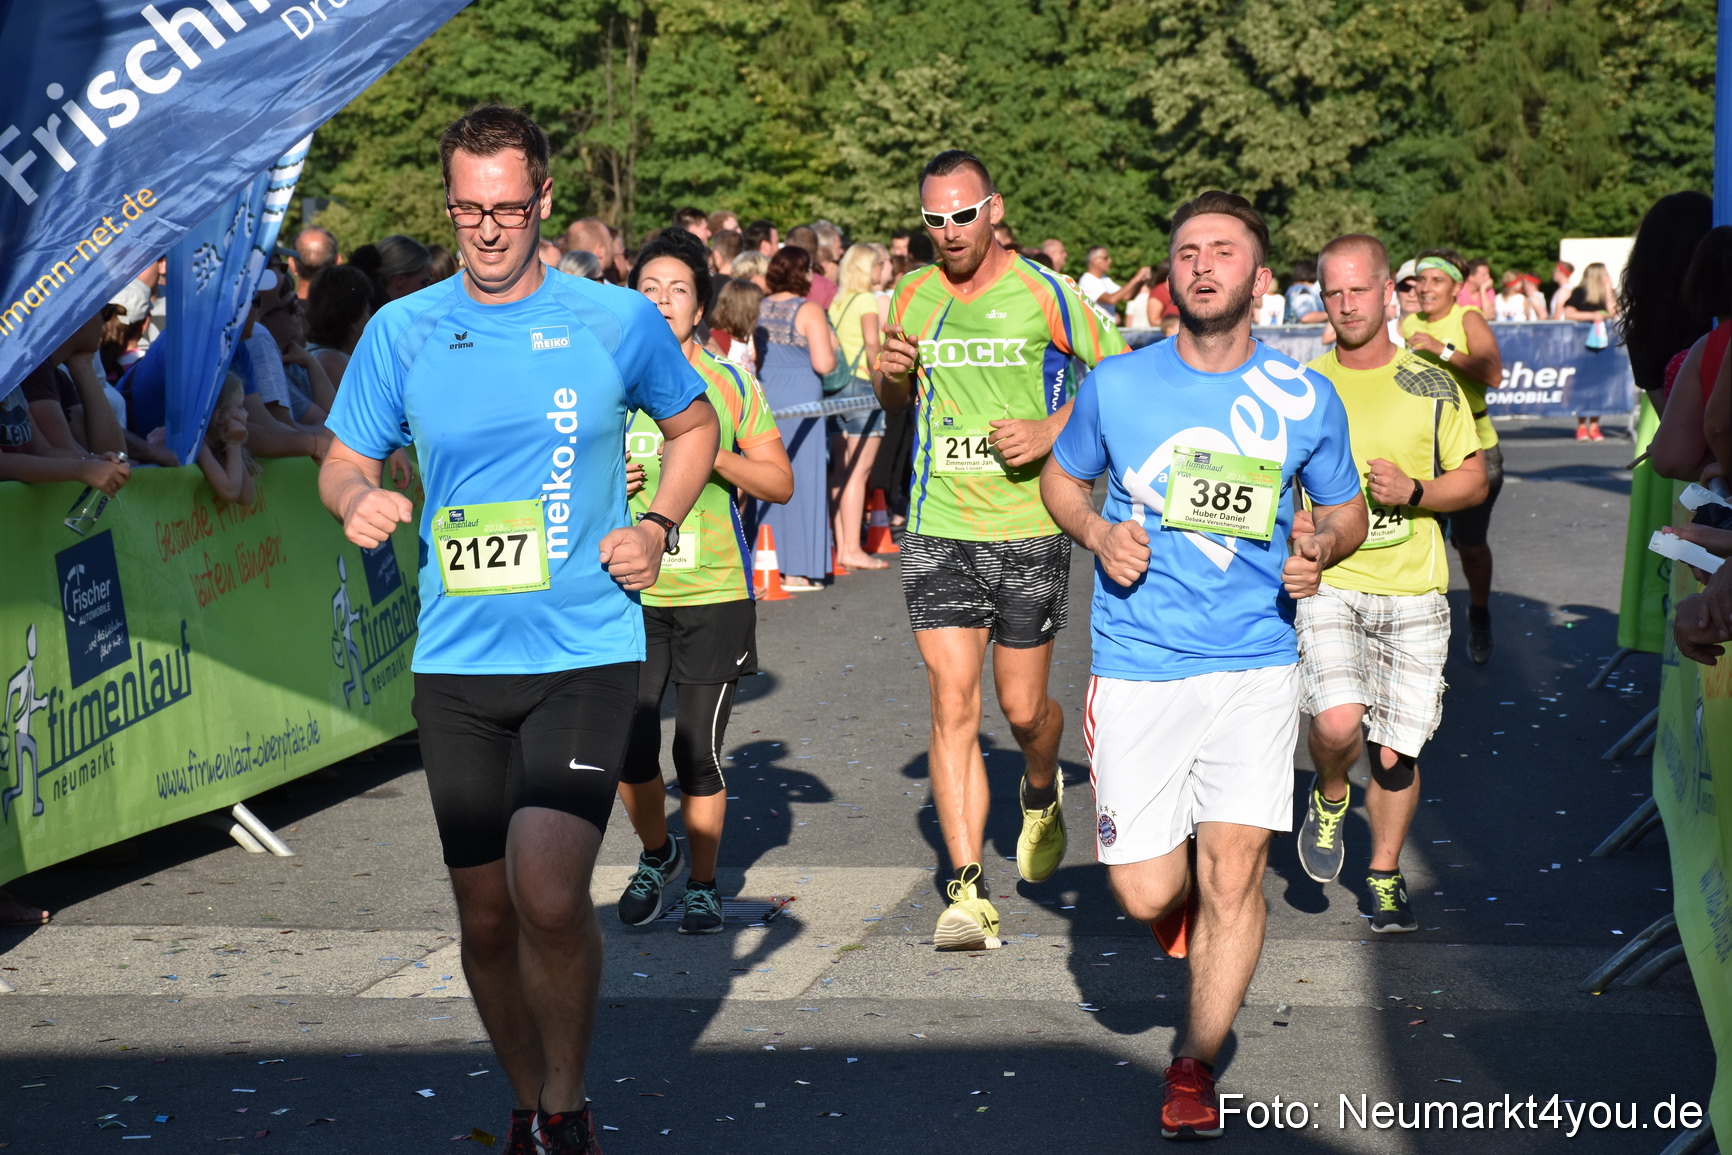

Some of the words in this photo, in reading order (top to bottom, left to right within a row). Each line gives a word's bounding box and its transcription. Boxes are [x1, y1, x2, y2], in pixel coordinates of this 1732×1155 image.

[449, 340, 474, 350] erima
[918, 338, 1028, 368] BOCK
[945, 437, 990, 459] 214
[542, 387, 578, 560] meiko.de
[1185, 460, 1224, 472] firmenlauf
[1189, 479, 1254, 514] 385
[443, 518, 479, 530] firmenlauf
[1192, 508, 1218, 519] Huber
[1219, 512, 1246, 523] Daniel
[1206, 518, 1250, 530] Versicherungen
[1370, 529, 1396, 537] Michael
[446, 533, 528, 571] 2127
[72, 578, 111, 614] Fischer
[78, 602, 111, 627] AUTOMOBILE
[48, 619, 192, 762] firmenlauf
[156, 709, 321, 800] www.firmenlauf-oberpfalz.de
[53, 741, 116, 802] neumarkt
